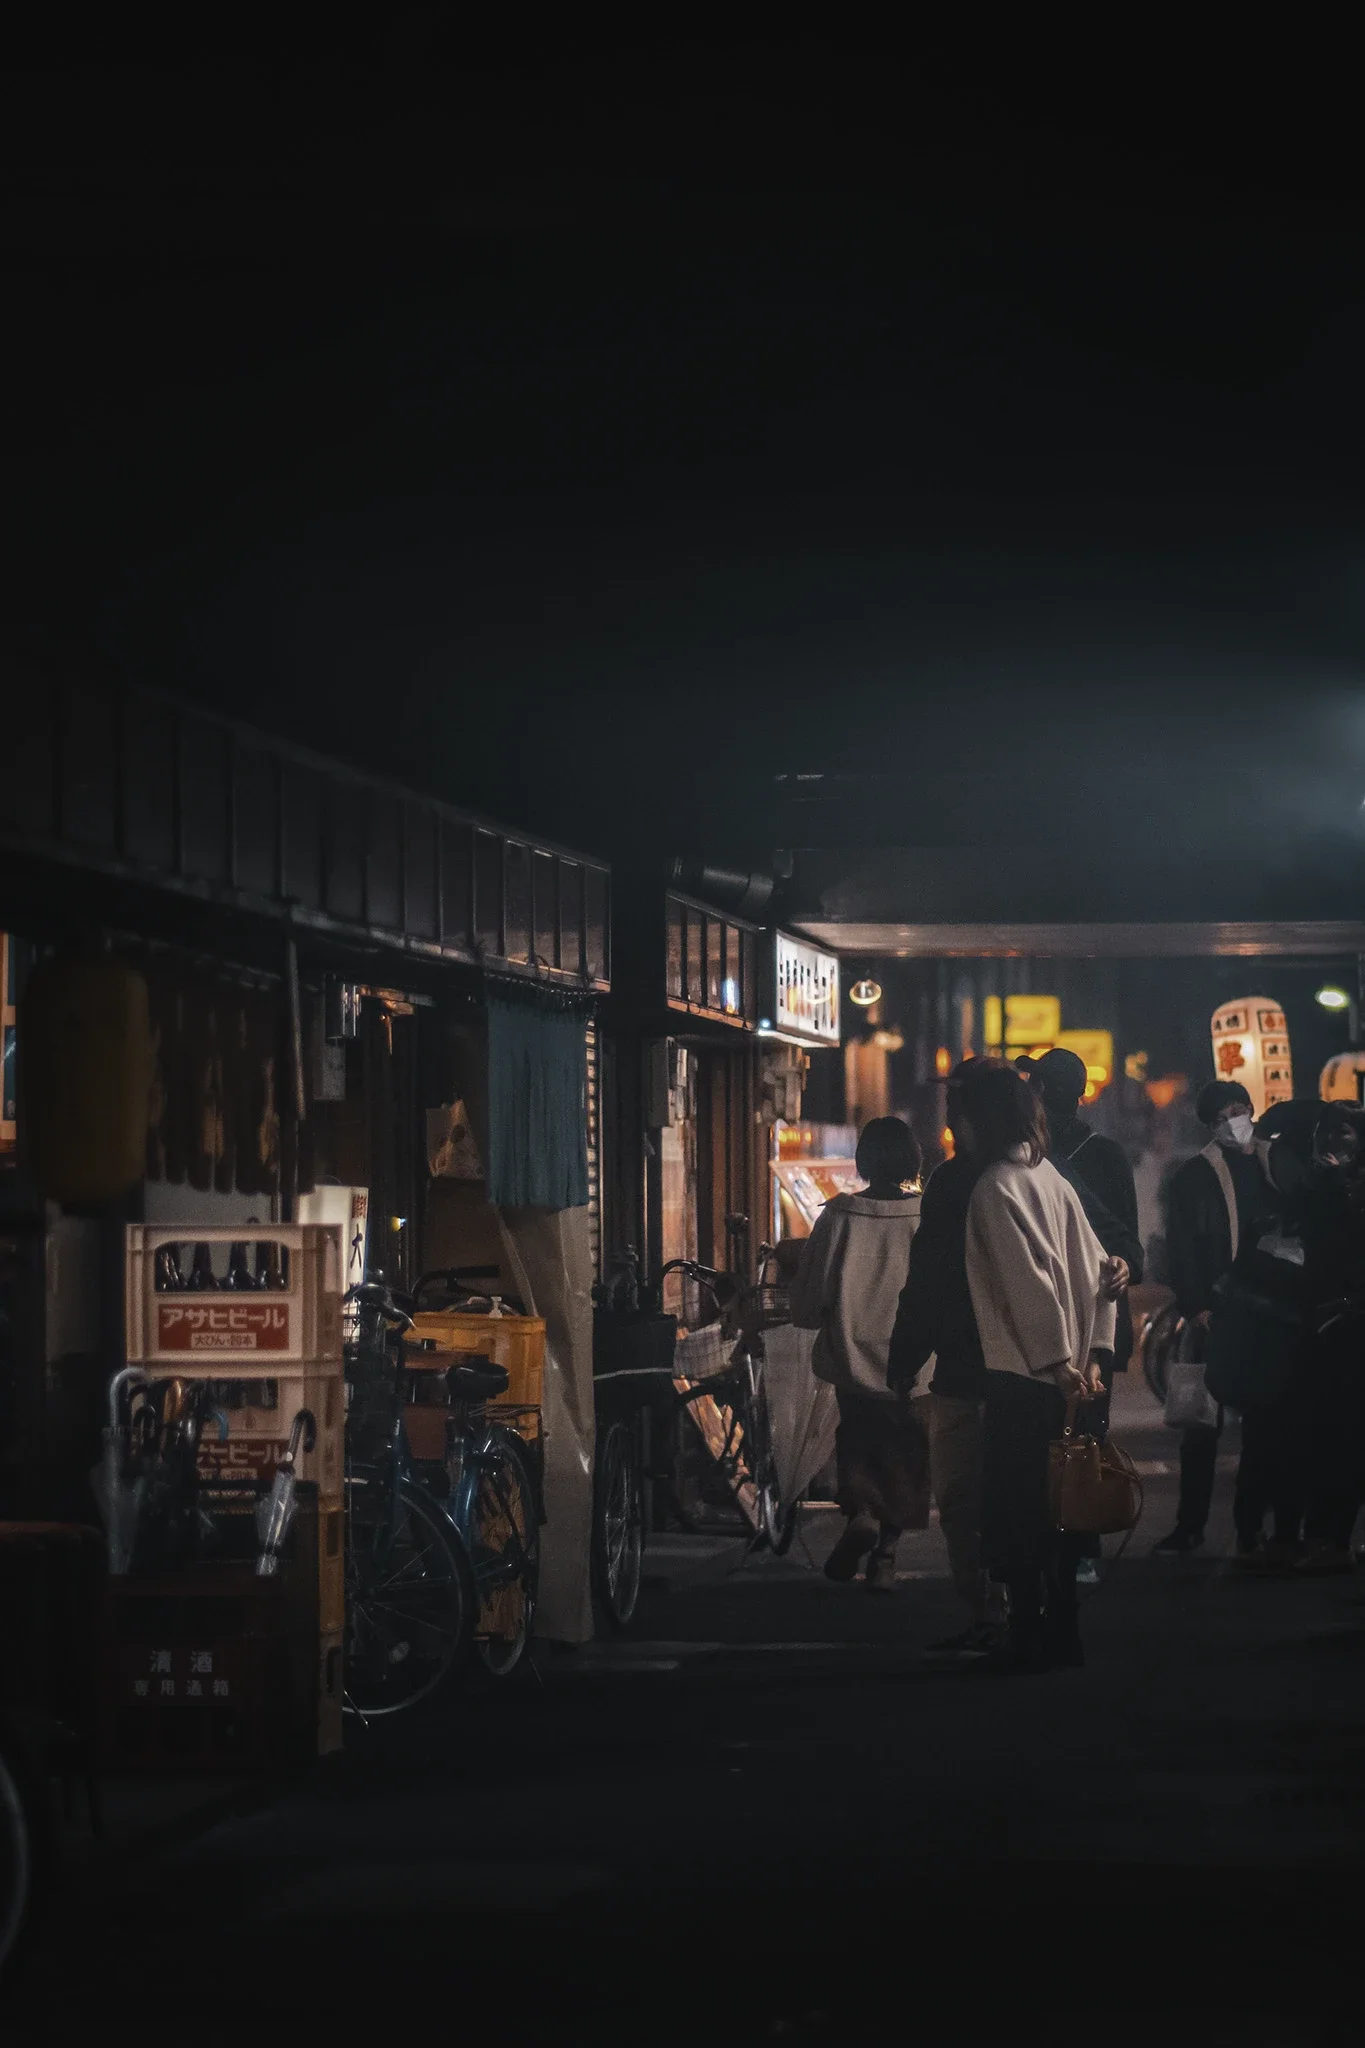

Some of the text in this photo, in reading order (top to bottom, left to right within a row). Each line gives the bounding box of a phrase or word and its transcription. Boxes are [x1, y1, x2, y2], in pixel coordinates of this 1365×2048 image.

[162, 1308, 286, 1329] アサヒビール
[149, 1649, 213, 1673] 清酒
